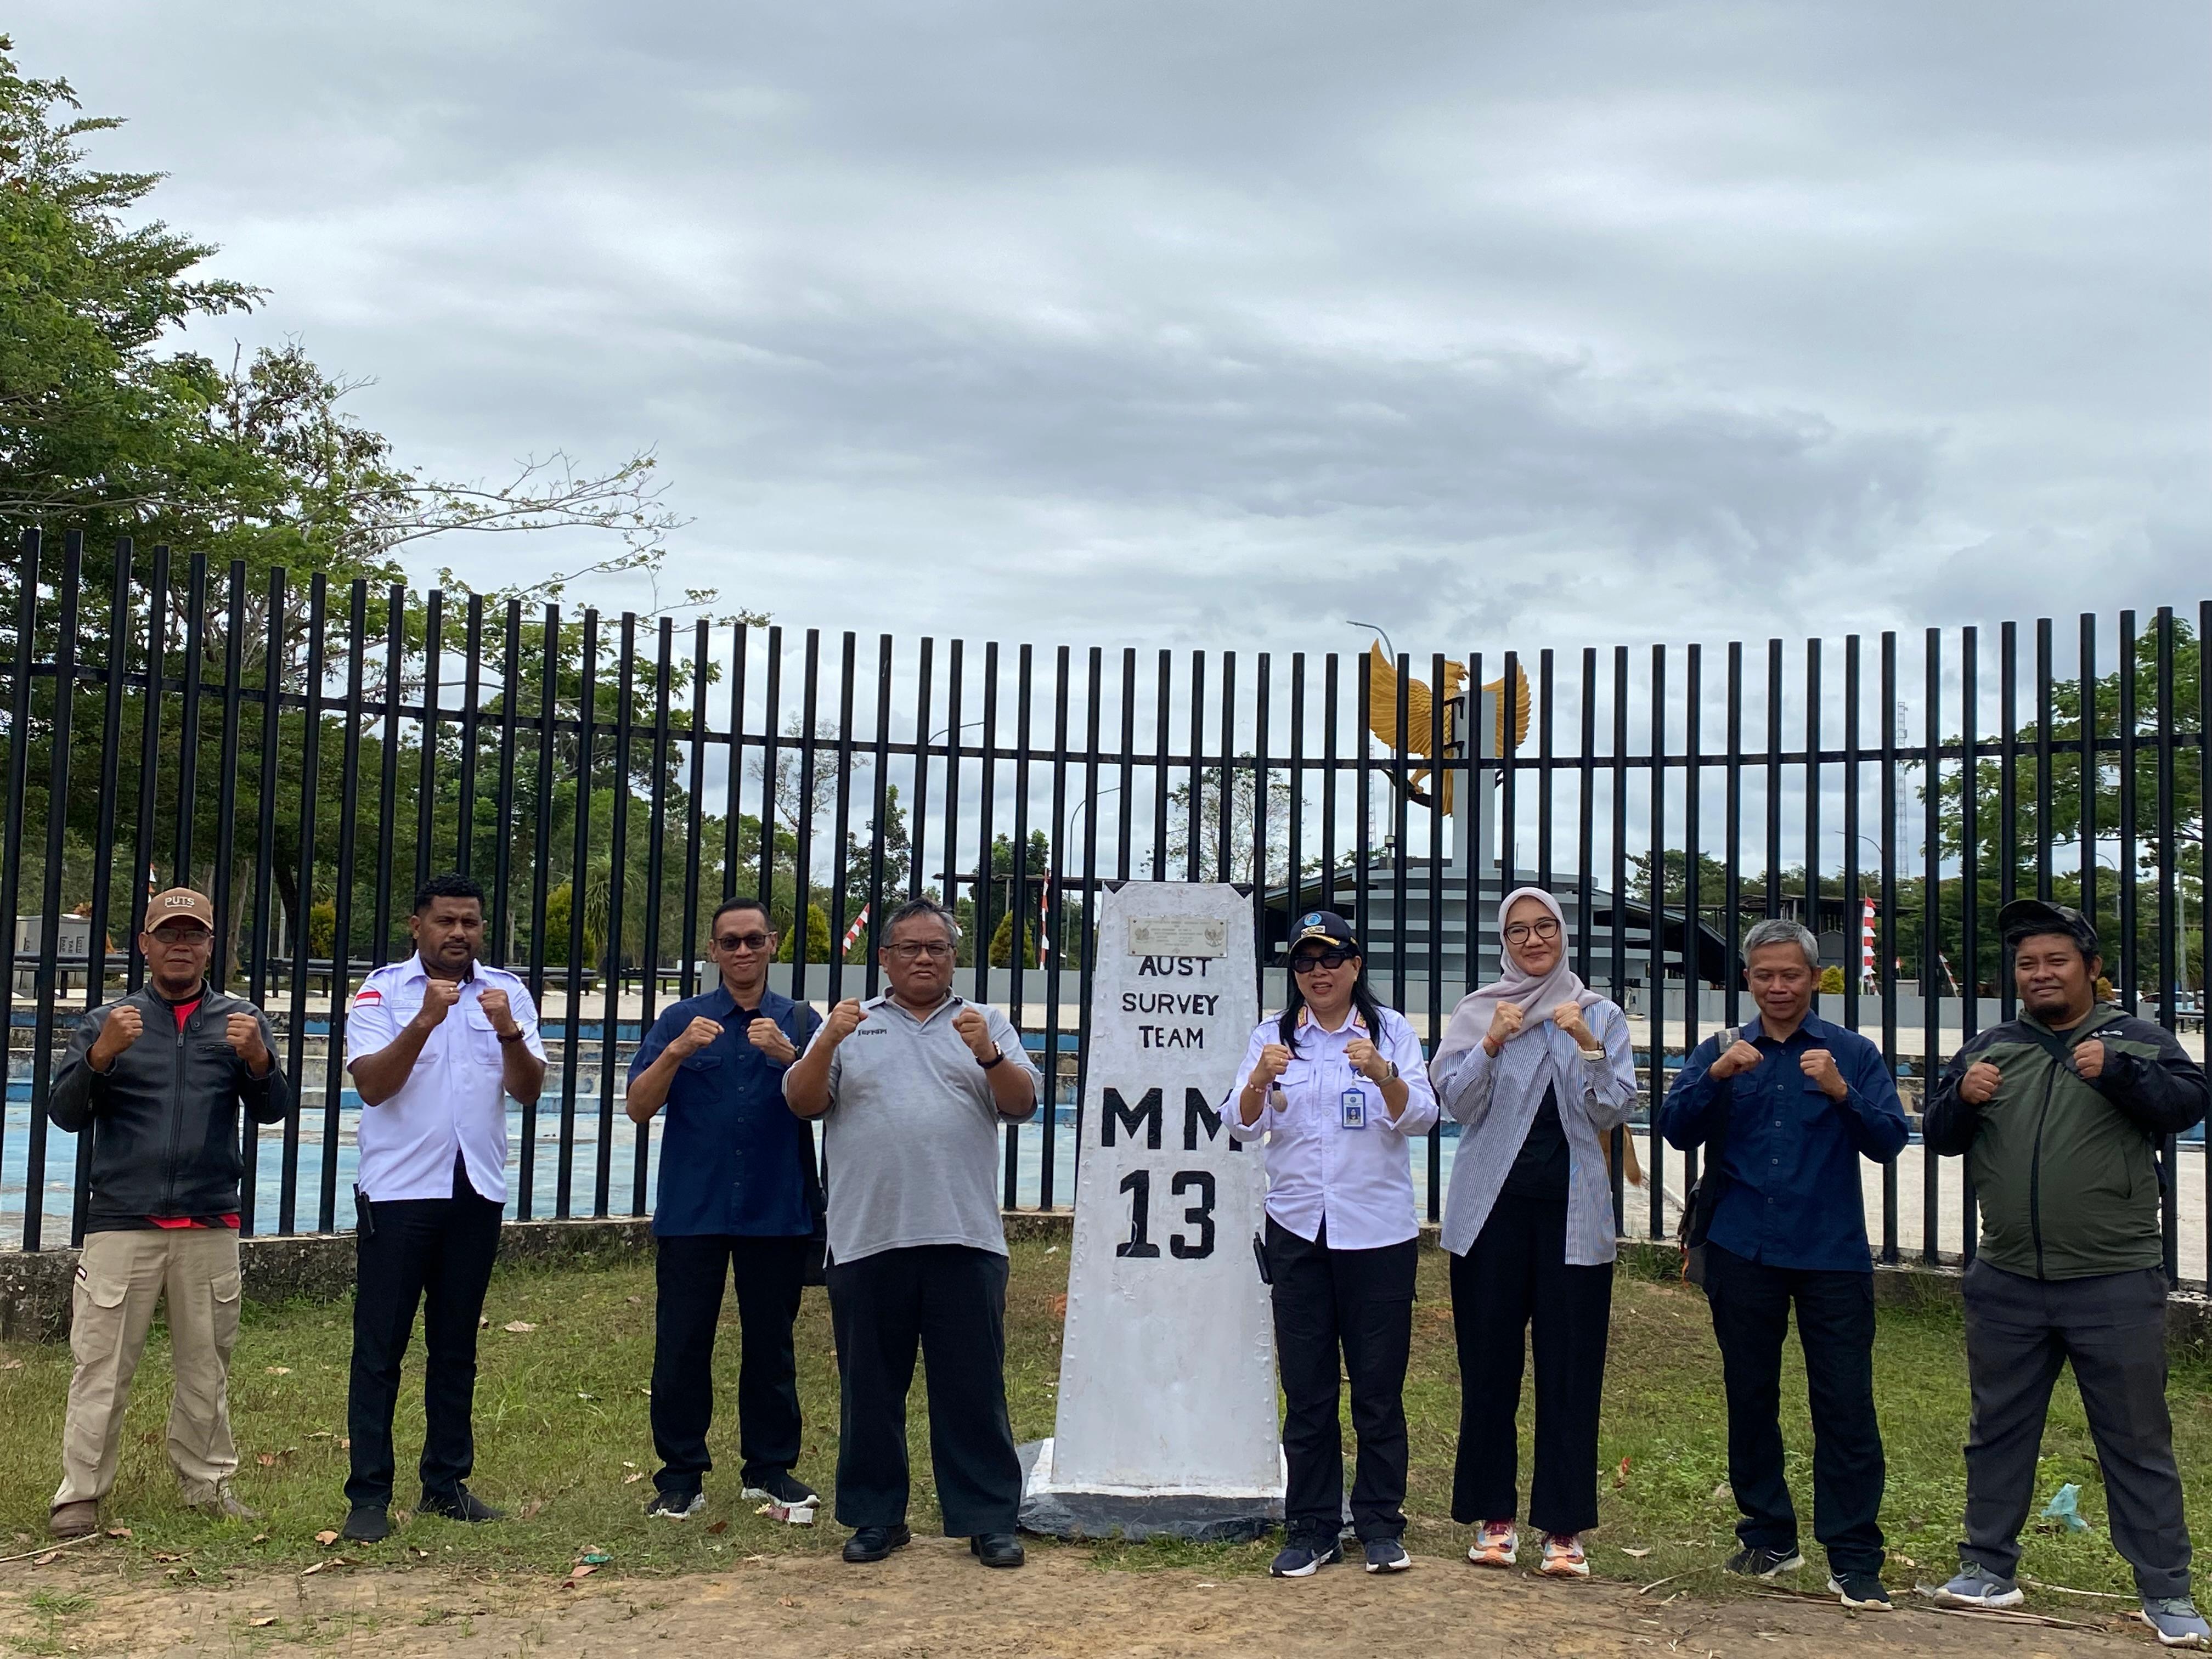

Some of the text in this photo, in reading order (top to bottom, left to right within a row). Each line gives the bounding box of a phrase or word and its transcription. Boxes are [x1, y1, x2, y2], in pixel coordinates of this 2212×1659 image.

[1138, 955, 1212, 977] AUST
[1122, 992, 1220, 1016] SURVEY
[1139, 1025, 1203, 1049] TEAM
[1101, 1087, 1243, 1152] MM
[1116, 1169, 1215, 1259] 13
